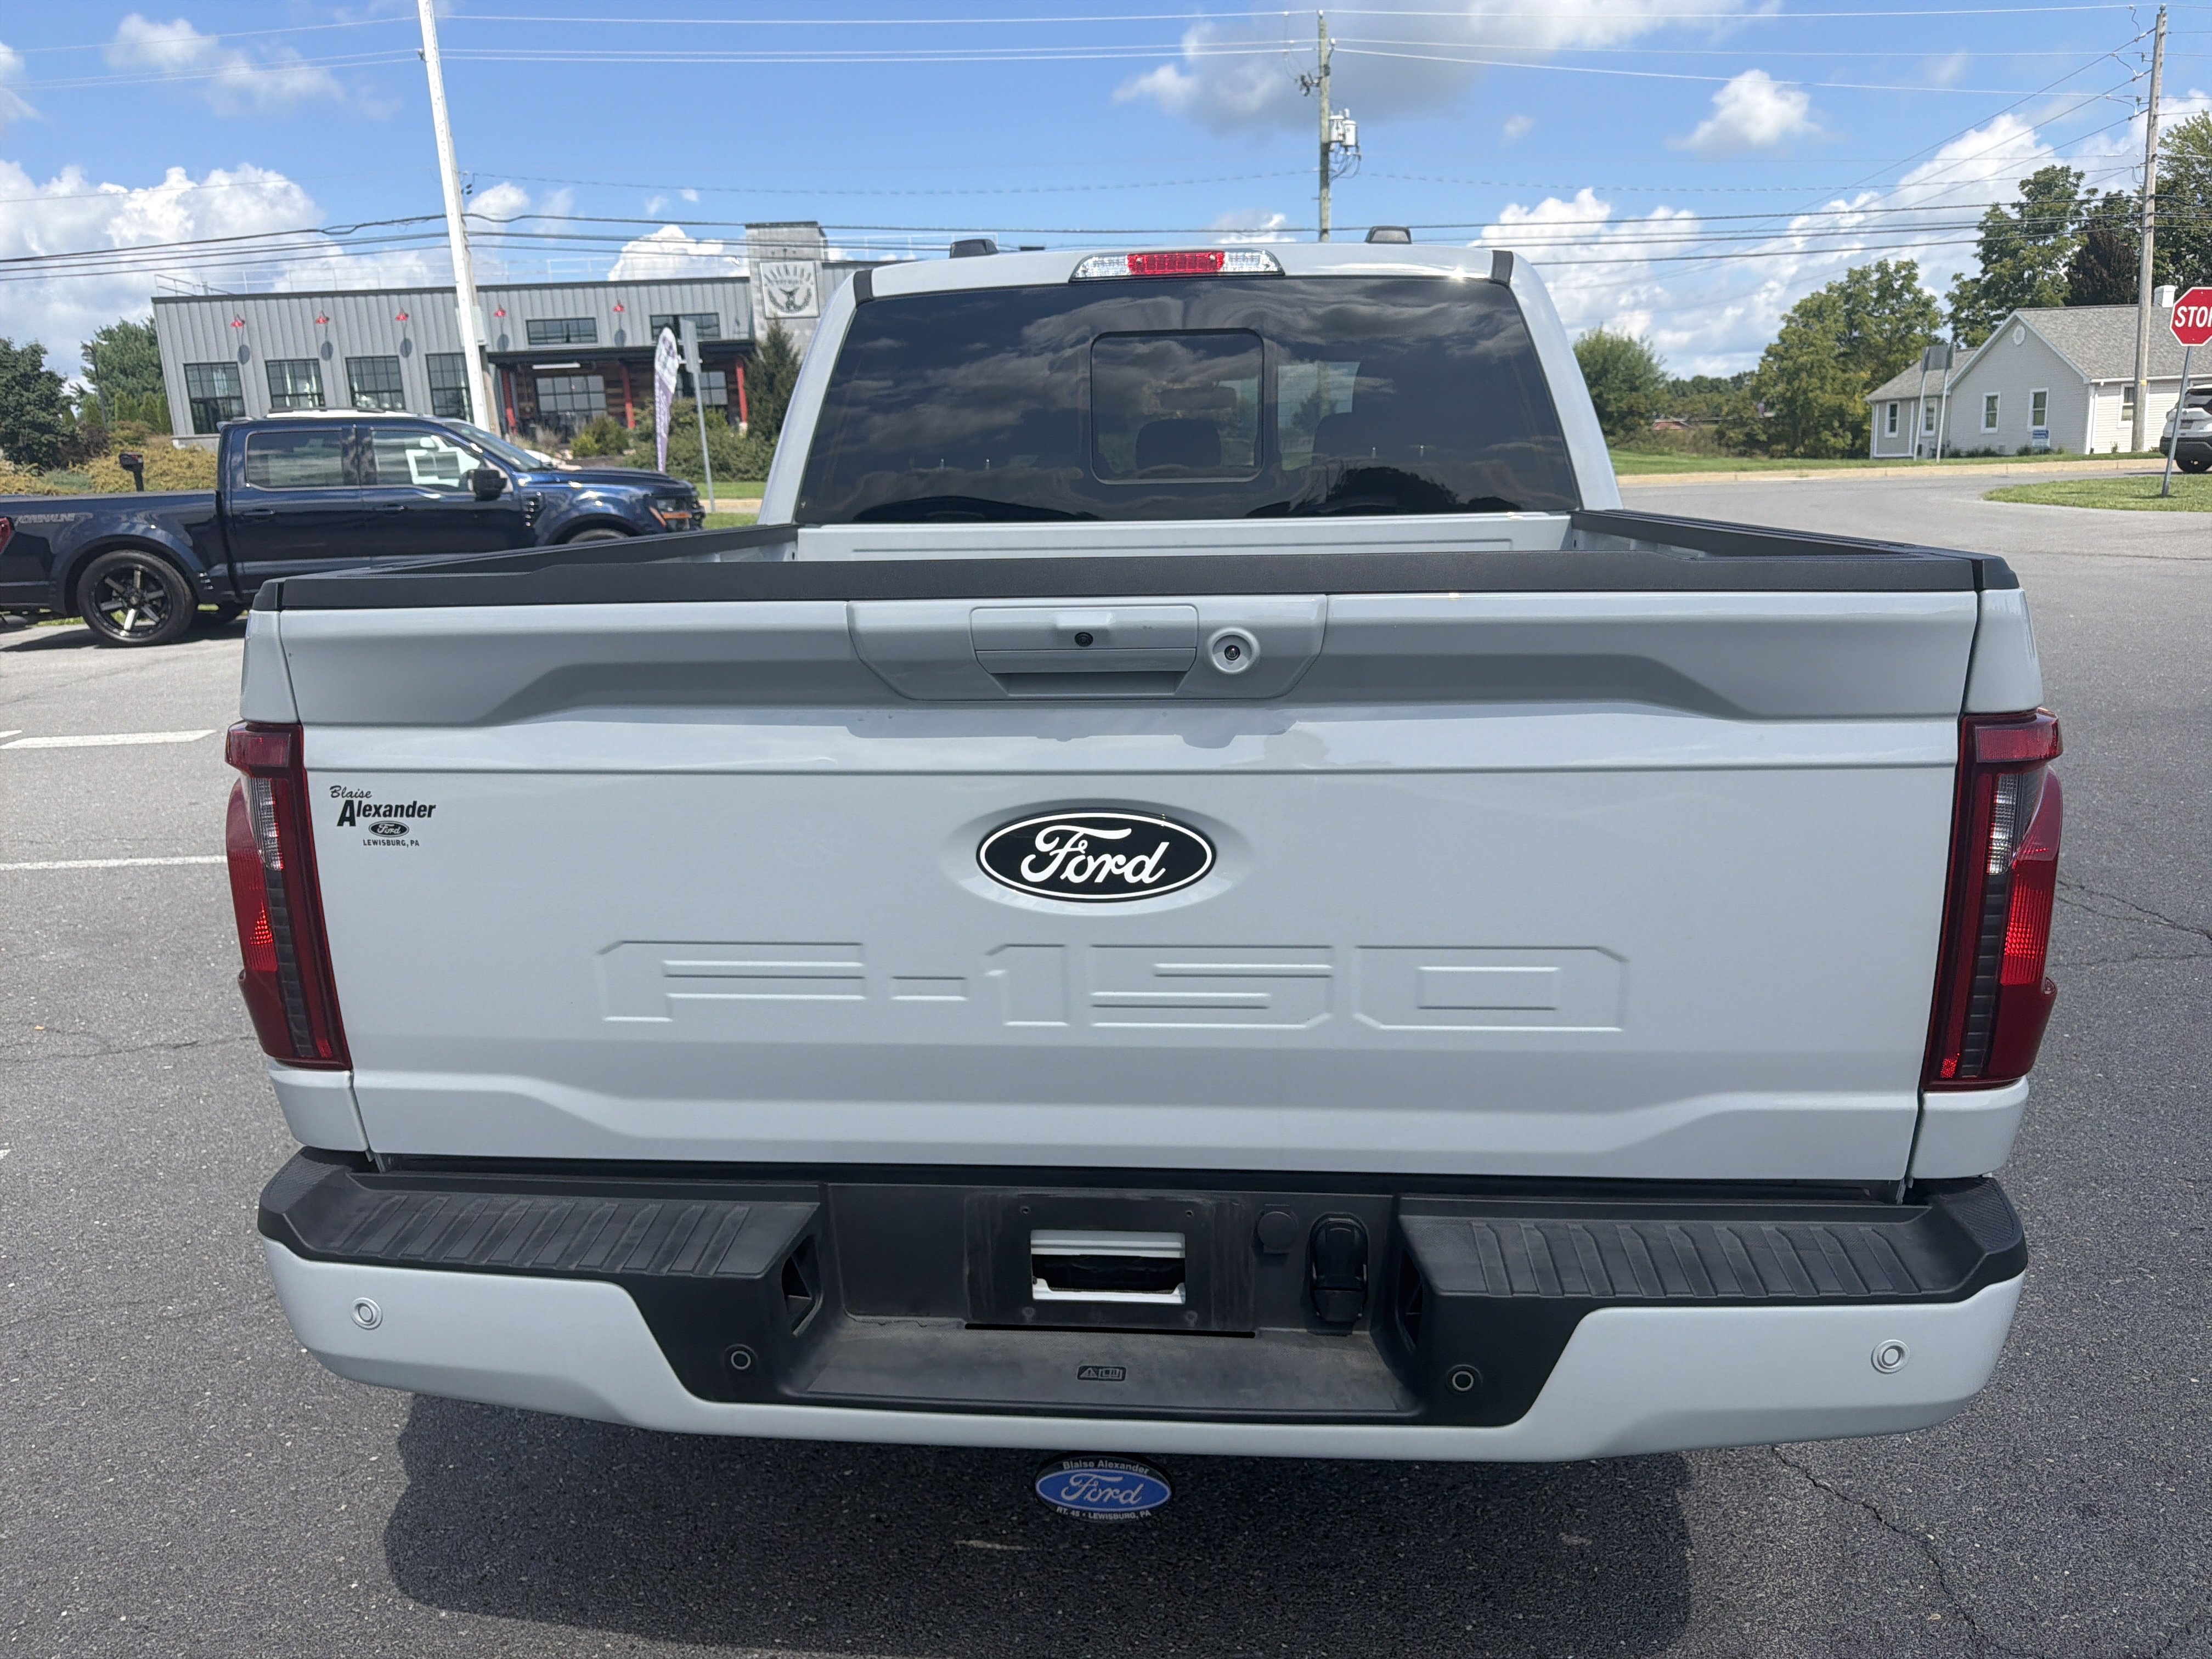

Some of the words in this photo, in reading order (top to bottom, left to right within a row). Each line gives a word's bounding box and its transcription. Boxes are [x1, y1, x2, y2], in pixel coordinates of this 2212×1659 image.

[329, 785, 373, 799] Blaise
[336, 799, 437, 827] Alexander
[376, 823, 402, 834] Ford
[363, 839, 409, 848] LEWISBURG,
[1020, 825, 1170, 884] Ford
[596, 940, 1627, 1035] F-150
[1062, 1459, 1095, 1470] Blaise
[1097, 1459, 1150, 1475] Alexander
[1060, 1473, 1144, 1504] Ford
[1088, 1511, 1139, 1520] LEWISBURG,
[1139, 1510, 1152, 1518] PA
